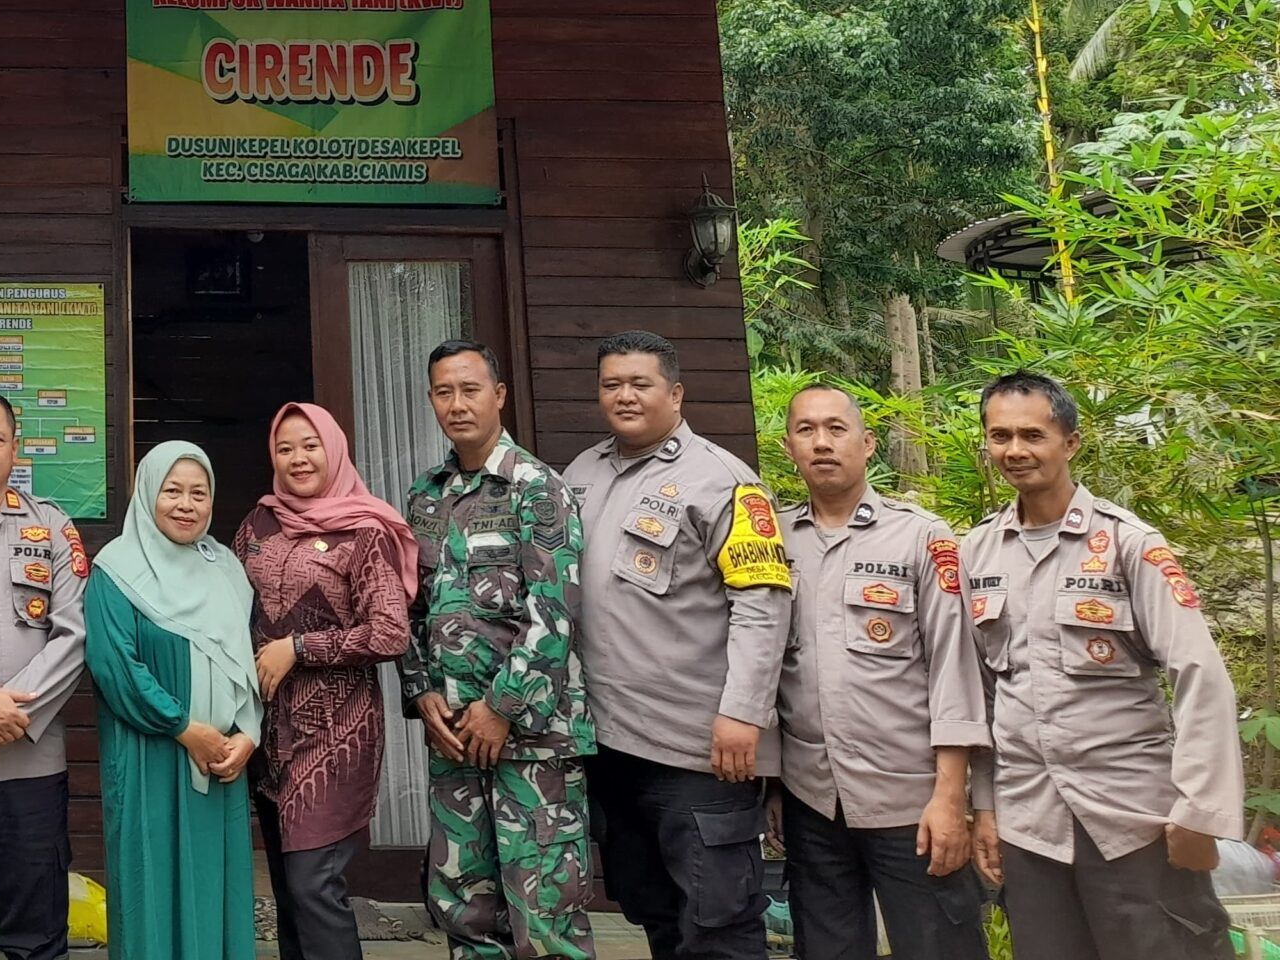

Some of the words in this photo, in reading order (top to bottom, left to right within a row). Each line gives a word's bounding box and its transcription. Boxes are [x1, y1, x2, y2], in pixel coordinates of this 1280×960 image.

[202, 38, 418, 102] CIRENDE
[167, 136, 233, 156] DUSUN
[236, 137, 289, 157] KEPEL
[291, 137, 354, 157] KOLOT
[357, 137, 404, 157] DESA
[405, 137, 461, 158] KEPEL
[245, 161, 314, 181] CISAGA
[7, 288, 66, 299] PENGURUS
[32, 302, 59, 315] TANI
[640, 496, 680, 519] POLRI
[13, 547, 52, 560] POLR
[853, 562, 908, 578] POLRI
[1064, 577, 1124, 593] POLRI
